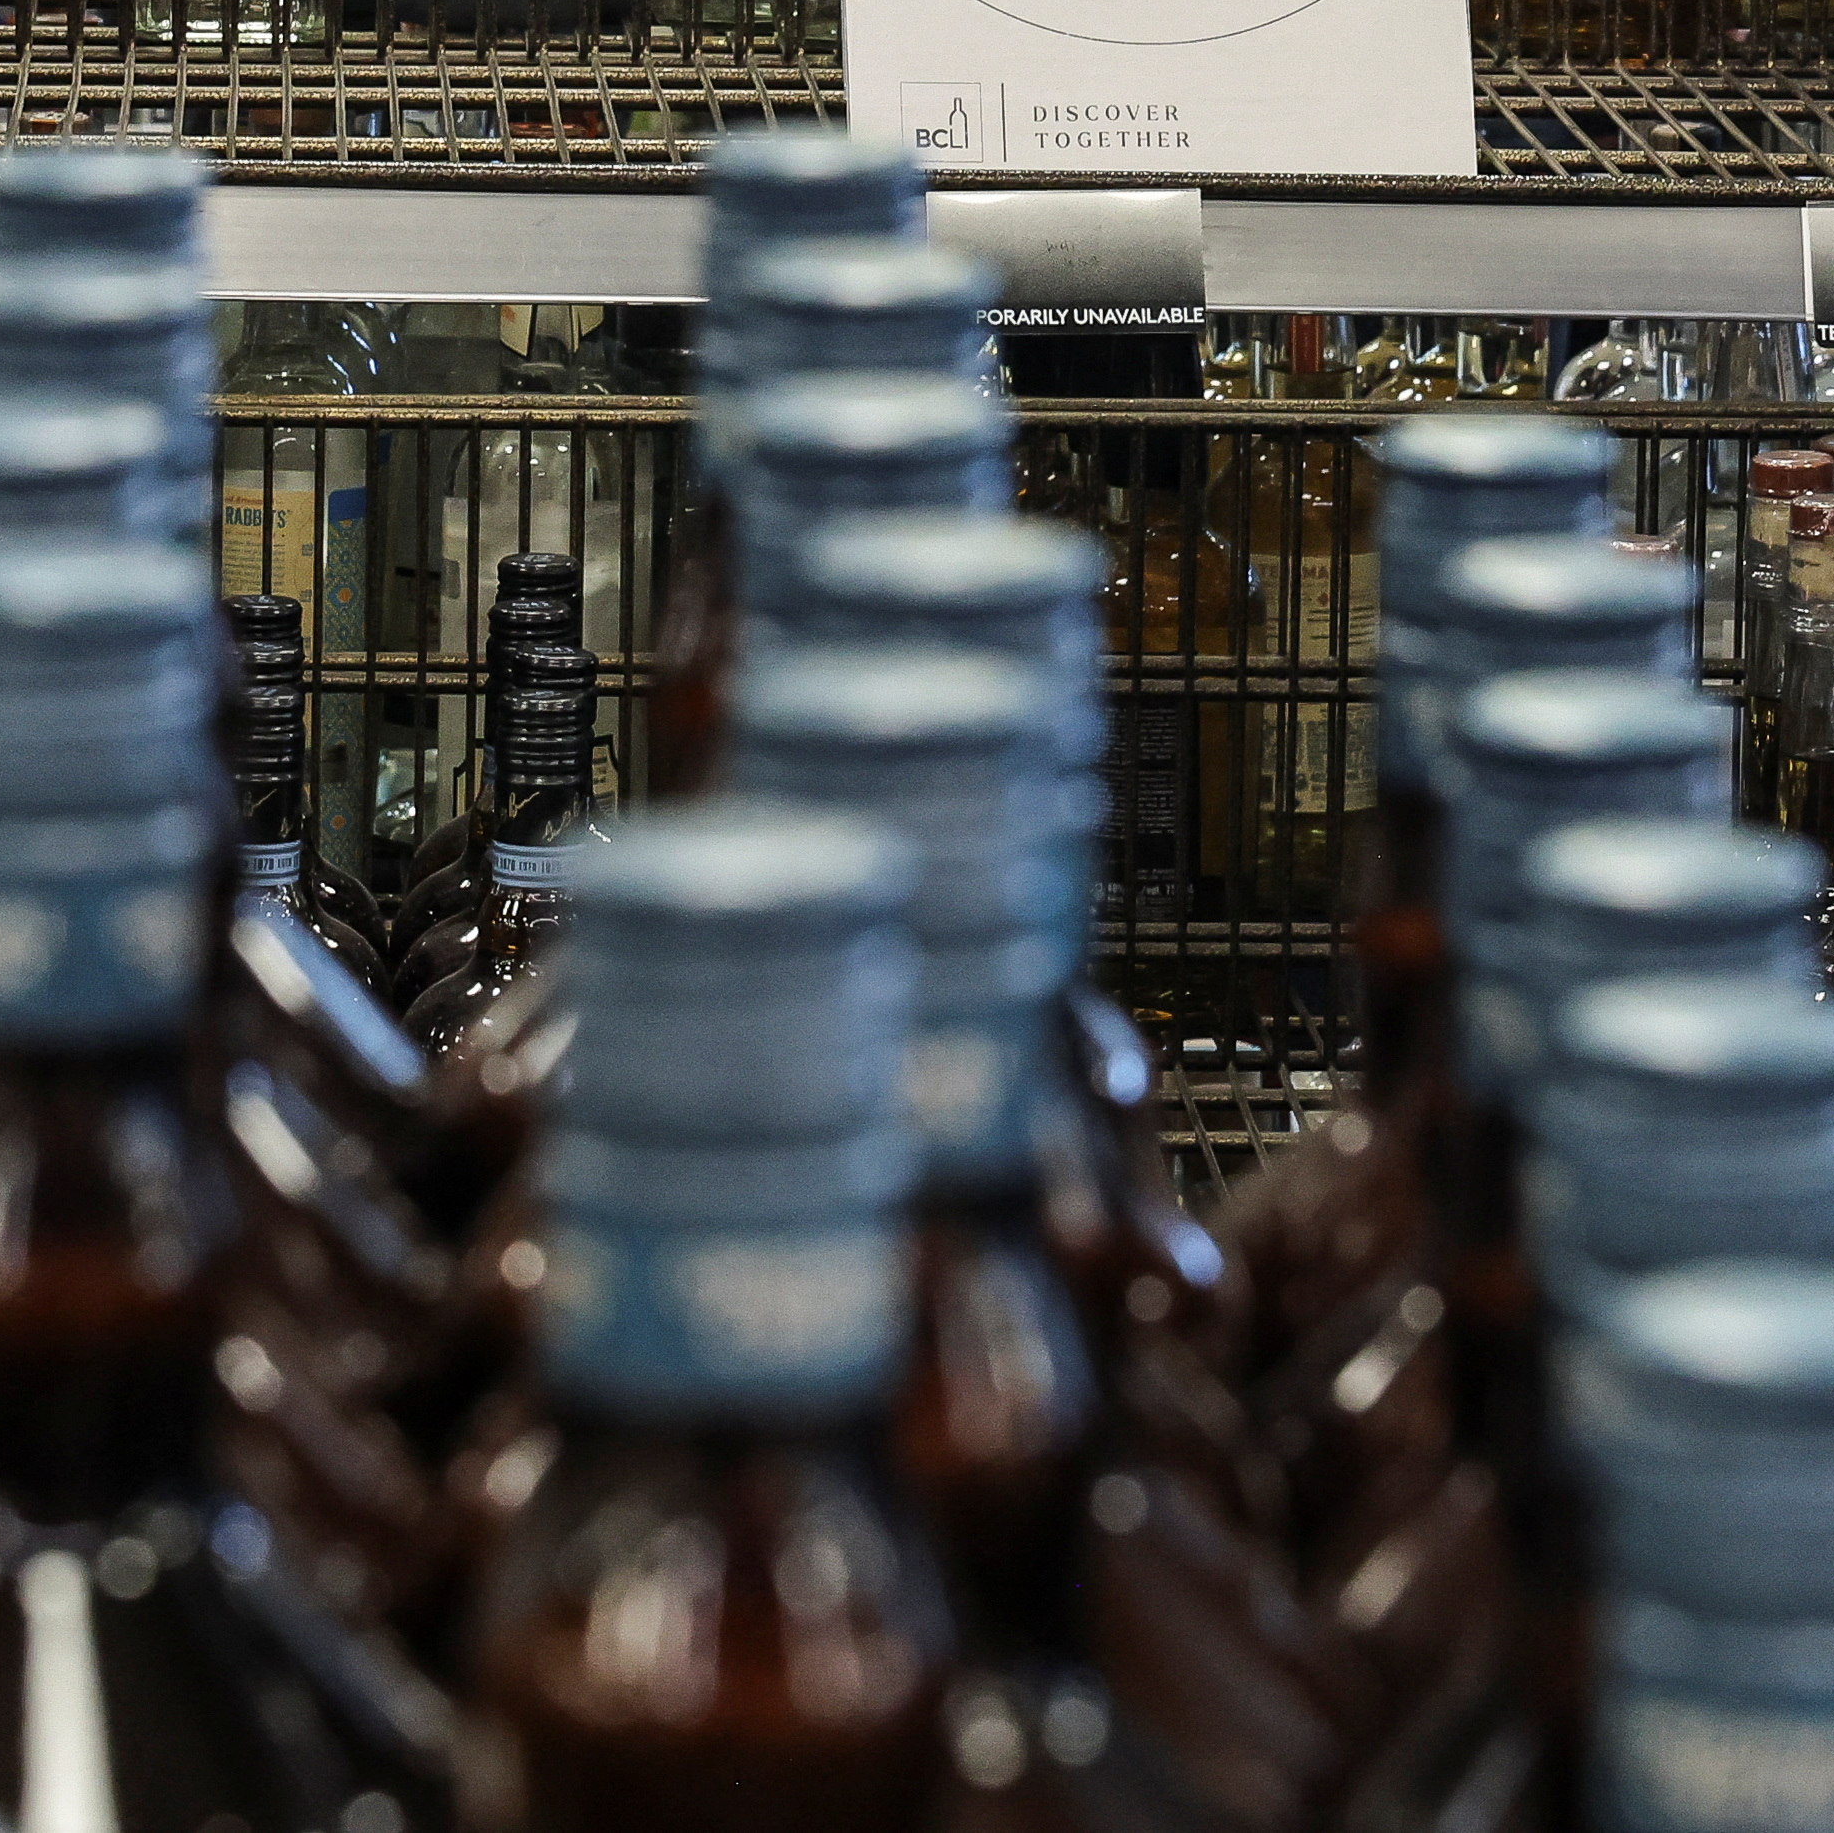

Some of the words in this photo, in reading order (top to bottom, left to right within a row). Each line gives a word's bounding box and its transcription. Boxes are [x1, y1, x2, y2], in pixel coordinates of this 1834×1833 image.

[1033, 104, 1179, 123] DISCOVER
[1035, 130, 1191, 149] TOGETHER
[976, 308, 1068, 326] PORARILY
[1073, 306, 1205, 324] UNAVAILABLE
